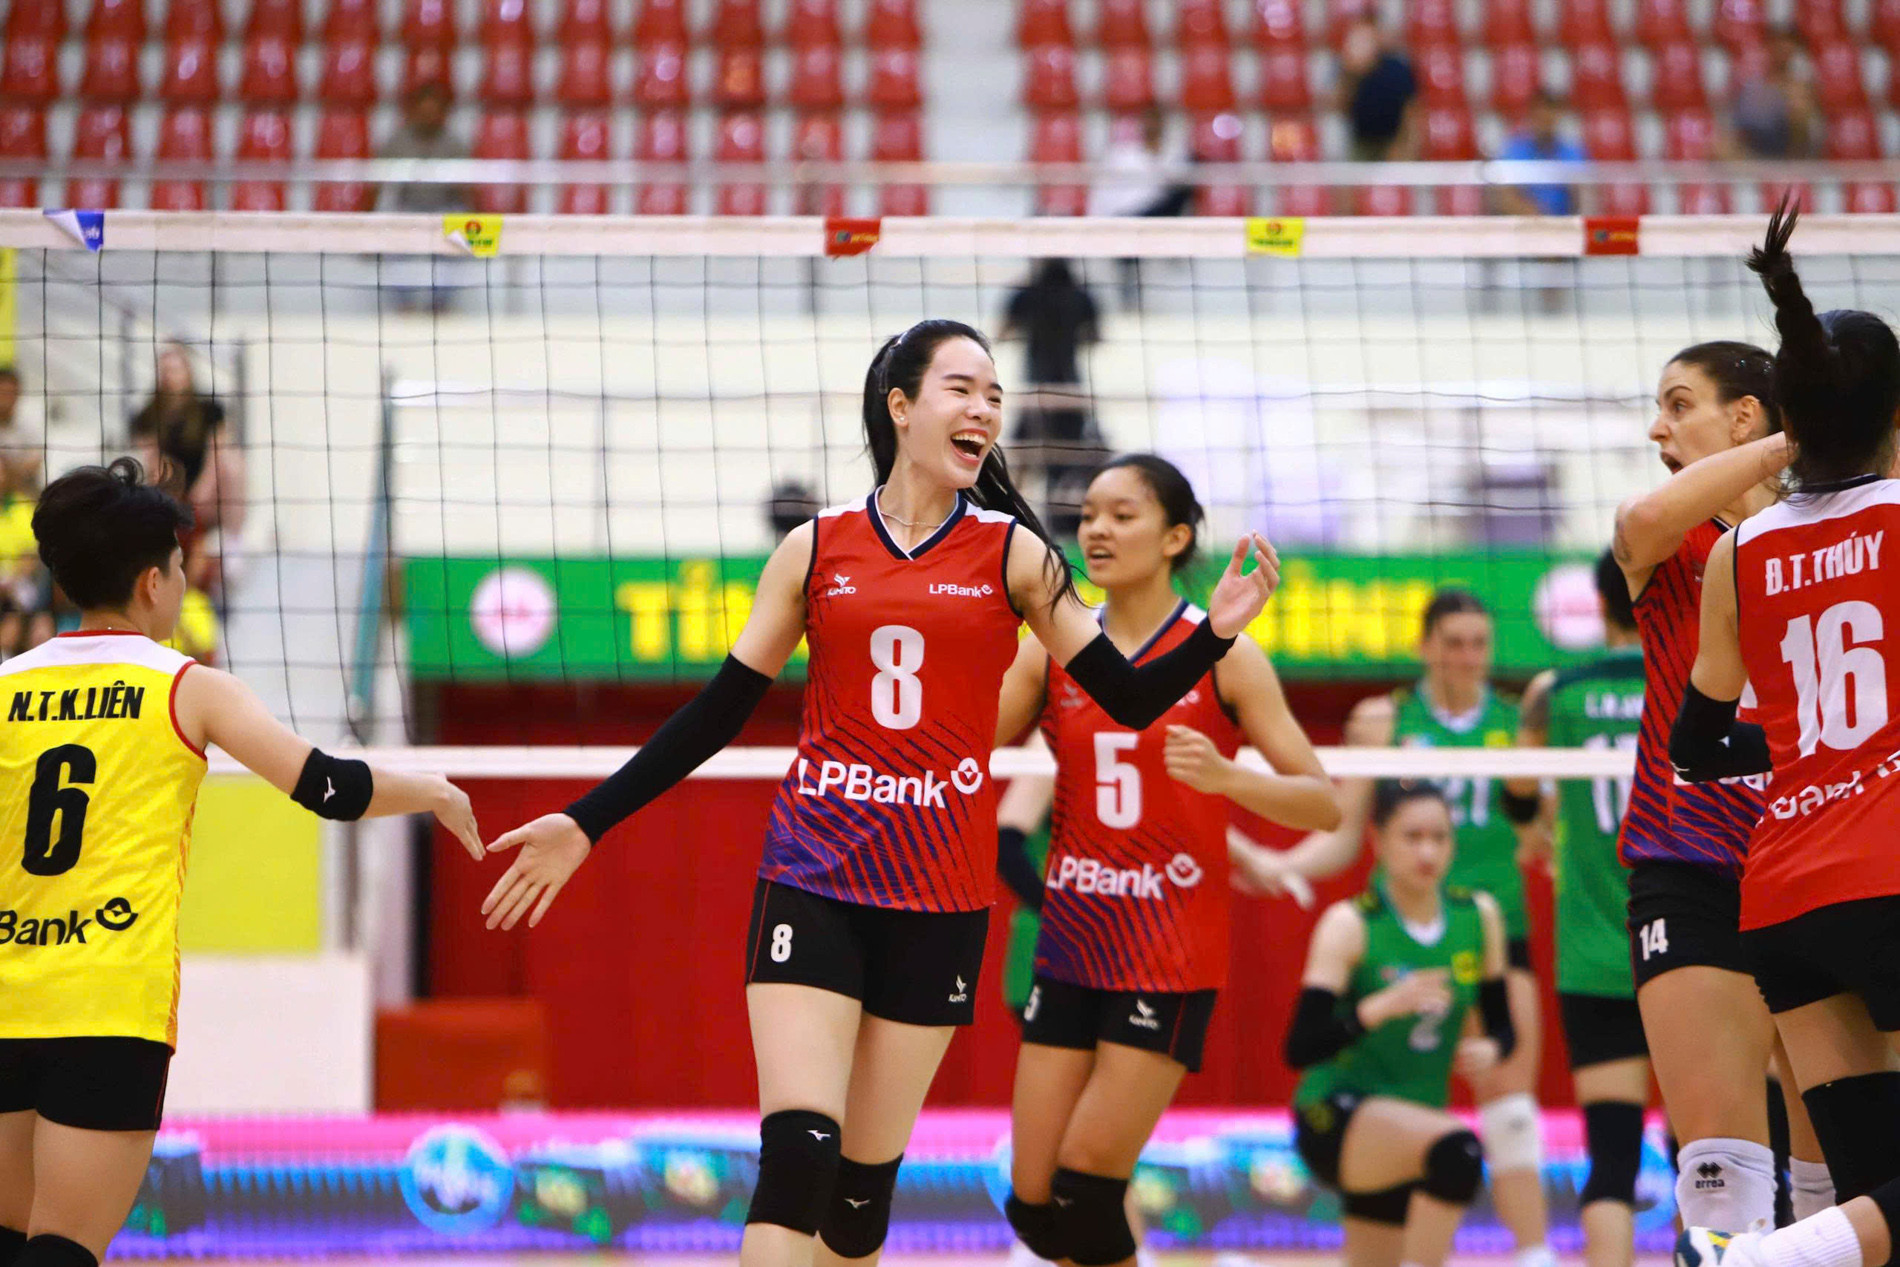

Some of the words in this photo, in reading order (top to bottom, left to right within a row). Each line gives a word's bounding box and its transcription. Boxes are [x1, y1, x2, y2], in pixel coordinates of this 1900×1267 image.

[1765, 530, 1884, 597] Đ.T.THÚY
[929, 583, 982, 598] LPBank
[8, 680, 145, 722] N.T.K.LIÊN
[869, 624, 926, 731] 8
[1779, 600, 1889, 760] 16
[797, 758, 949, 810] LPBank
[1093, 732, 1142, 829] 5
[21, 743, 97, 877] 6
[1046, 855, 1164, 900] LPBank
[770, 923, 793, 963] 8
[1639, 918, 1670, 961] 14
